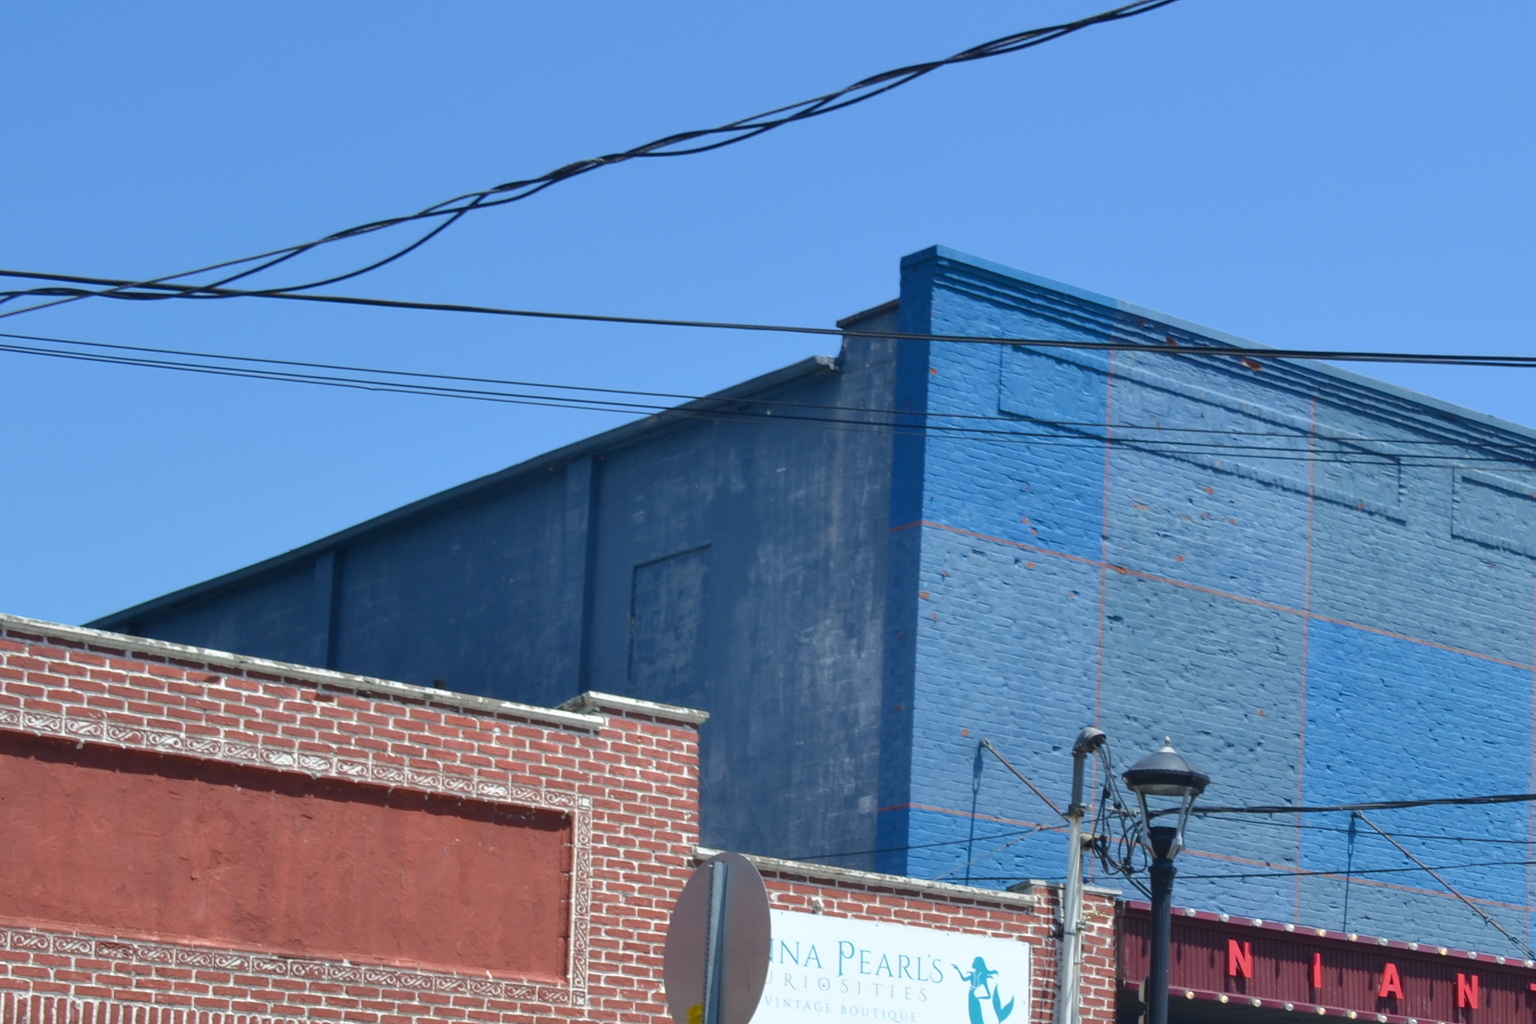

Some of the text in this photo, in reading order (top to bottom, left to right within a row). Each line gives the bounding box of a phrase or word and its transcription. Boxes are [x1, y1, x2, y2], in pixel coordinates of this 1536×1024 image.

[837, 940, 944, 984] PEARL'S
[764, 995, 917, 1024] VINTAGE BOUTIQUE
